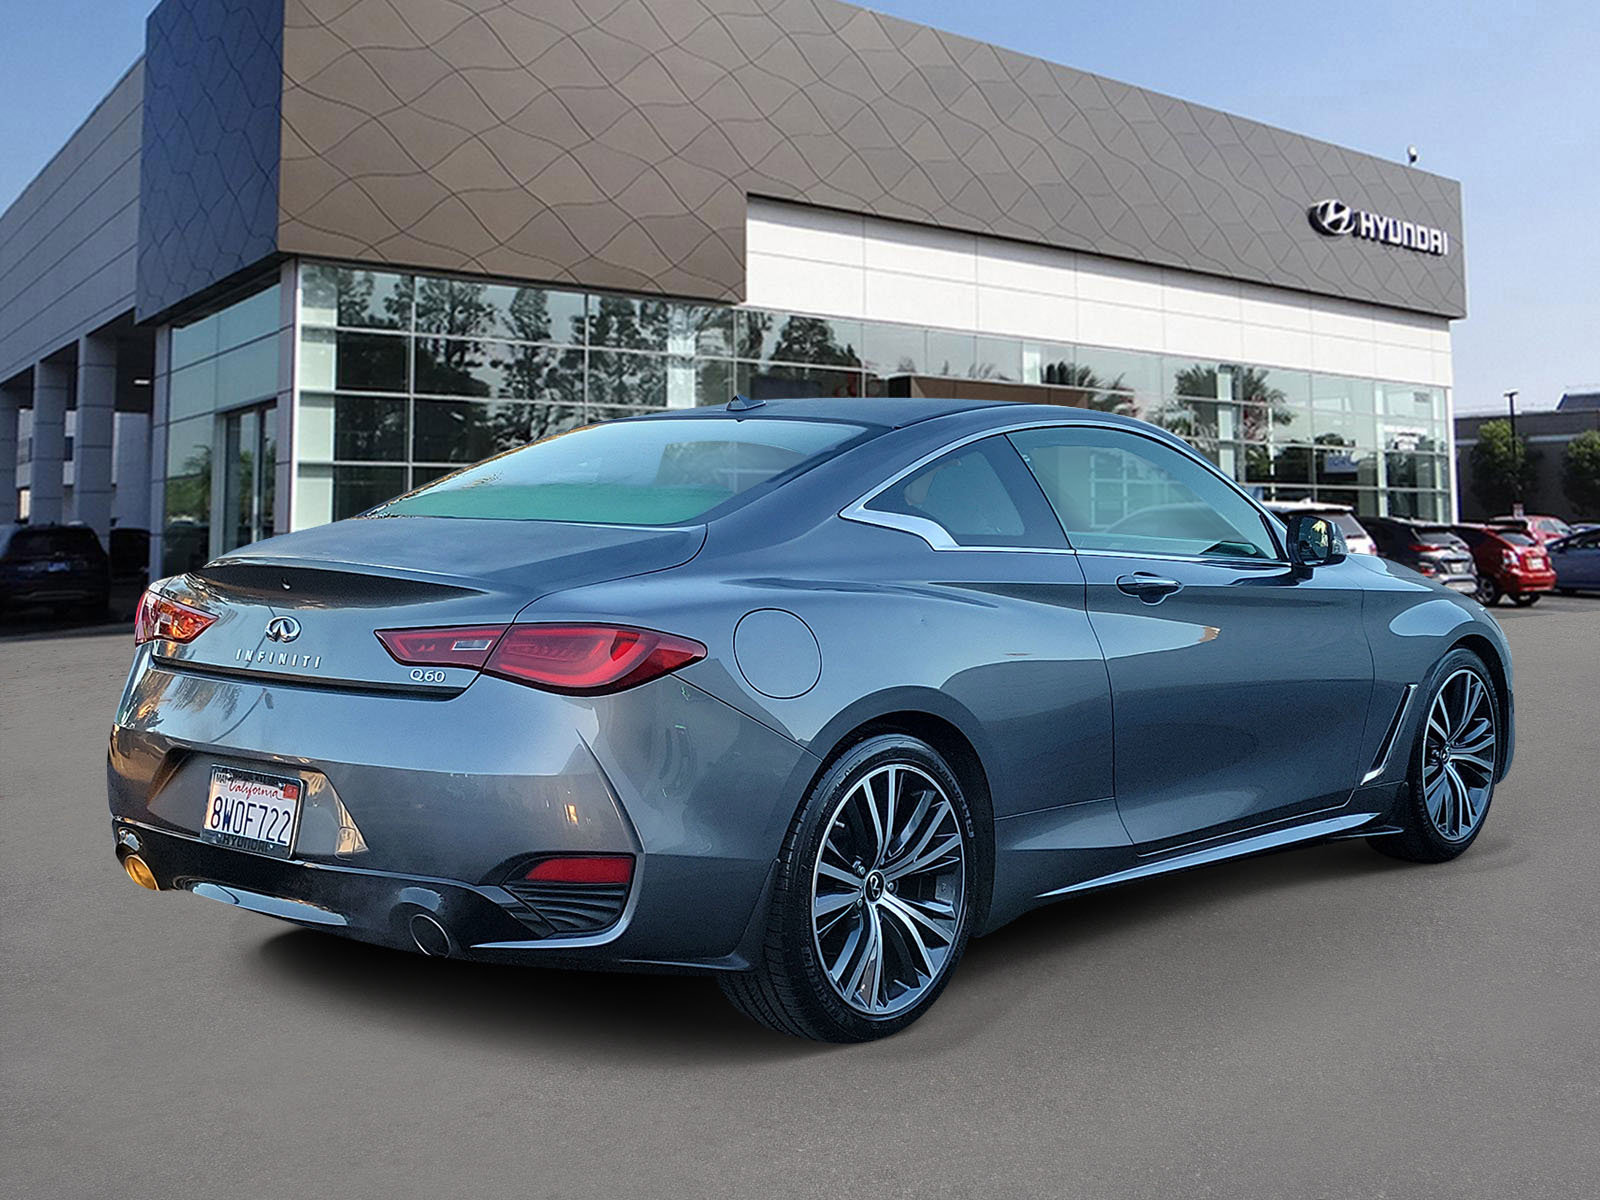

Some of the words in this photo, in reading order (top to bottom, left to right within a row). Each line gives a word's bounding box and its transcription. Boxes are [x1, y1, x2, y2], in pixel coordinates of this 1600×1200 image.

[1360, 211, 1448, 255] HYUNDAI
[235, 648, 321, 668] INFINITI
[410, 668, 446, 683] Q60
[228, 778, 283, 800] California
